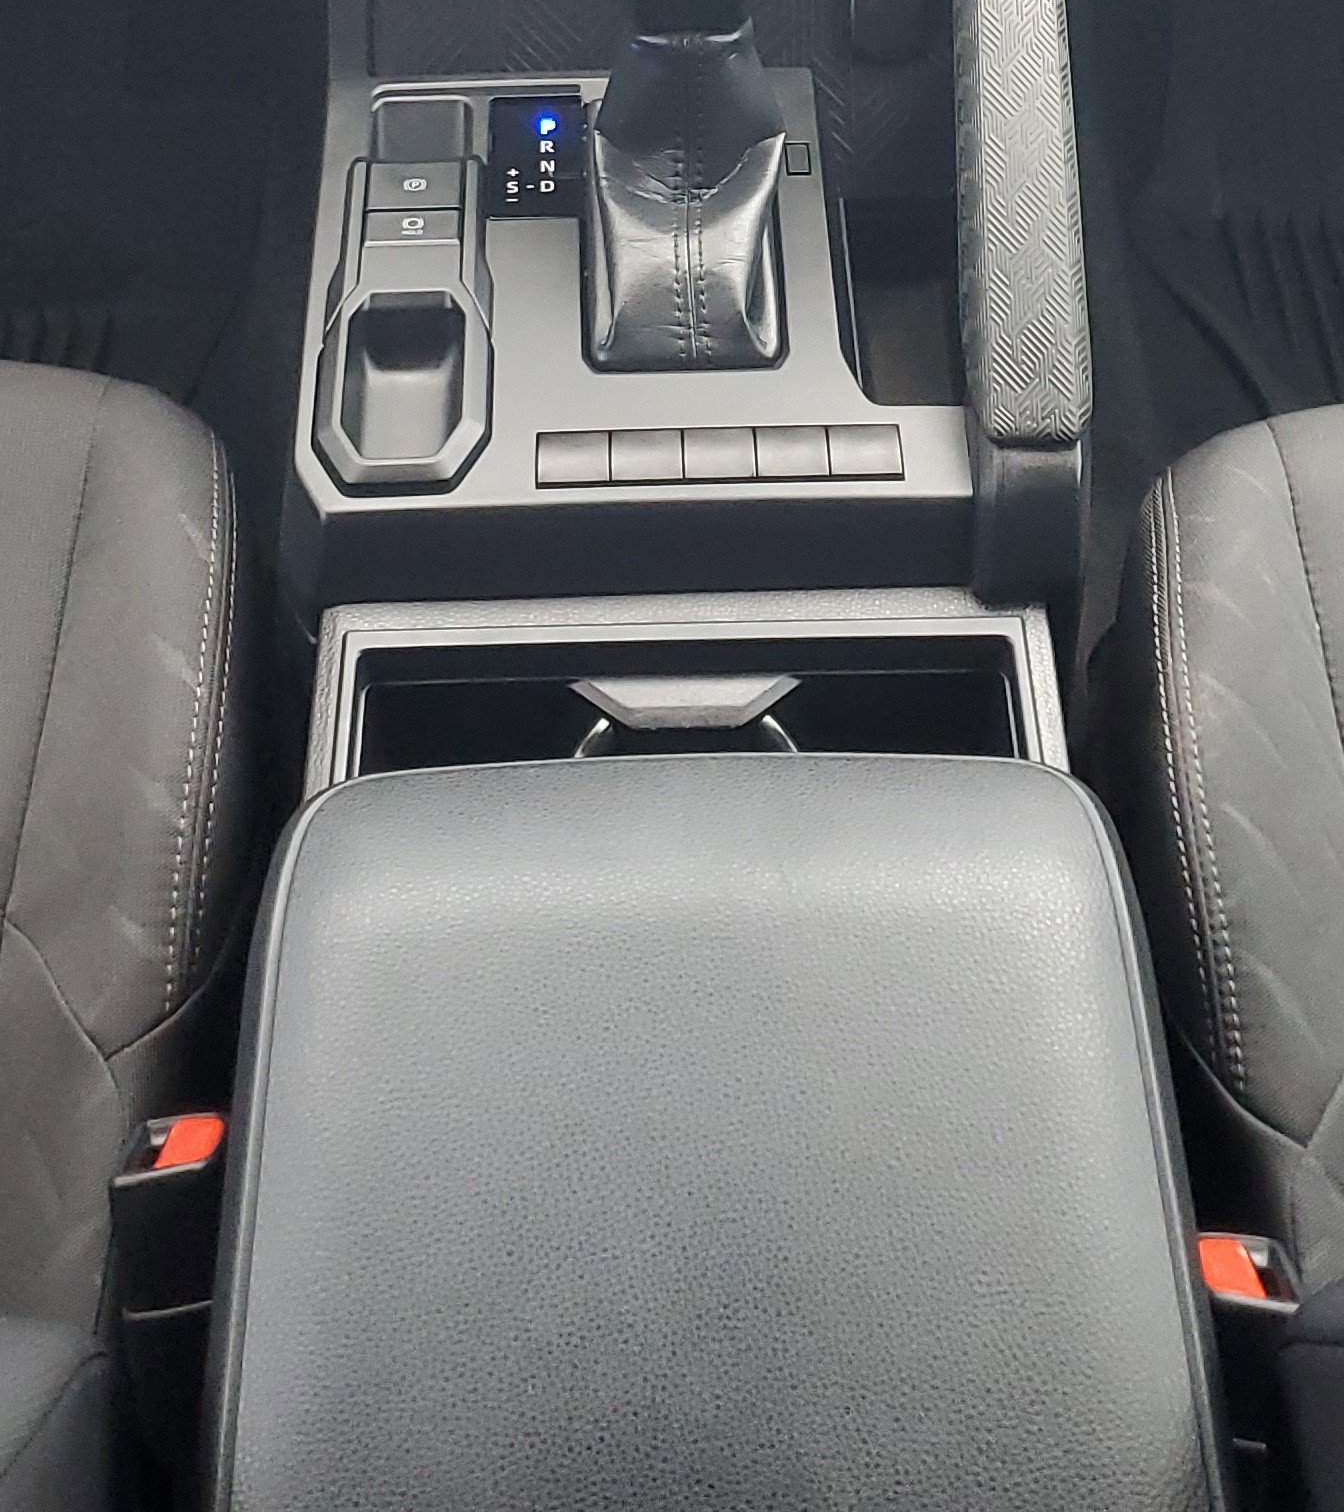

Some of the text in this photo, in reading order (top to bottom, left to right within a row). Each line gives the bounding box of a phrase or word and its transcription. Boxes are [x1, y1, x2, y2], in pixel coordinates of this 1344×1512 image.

[540, 117, 556, 135] P
[540, 140, 555, 153] R
[540, 159, 555, 173] N
[506, 180, 555, 194] S D
